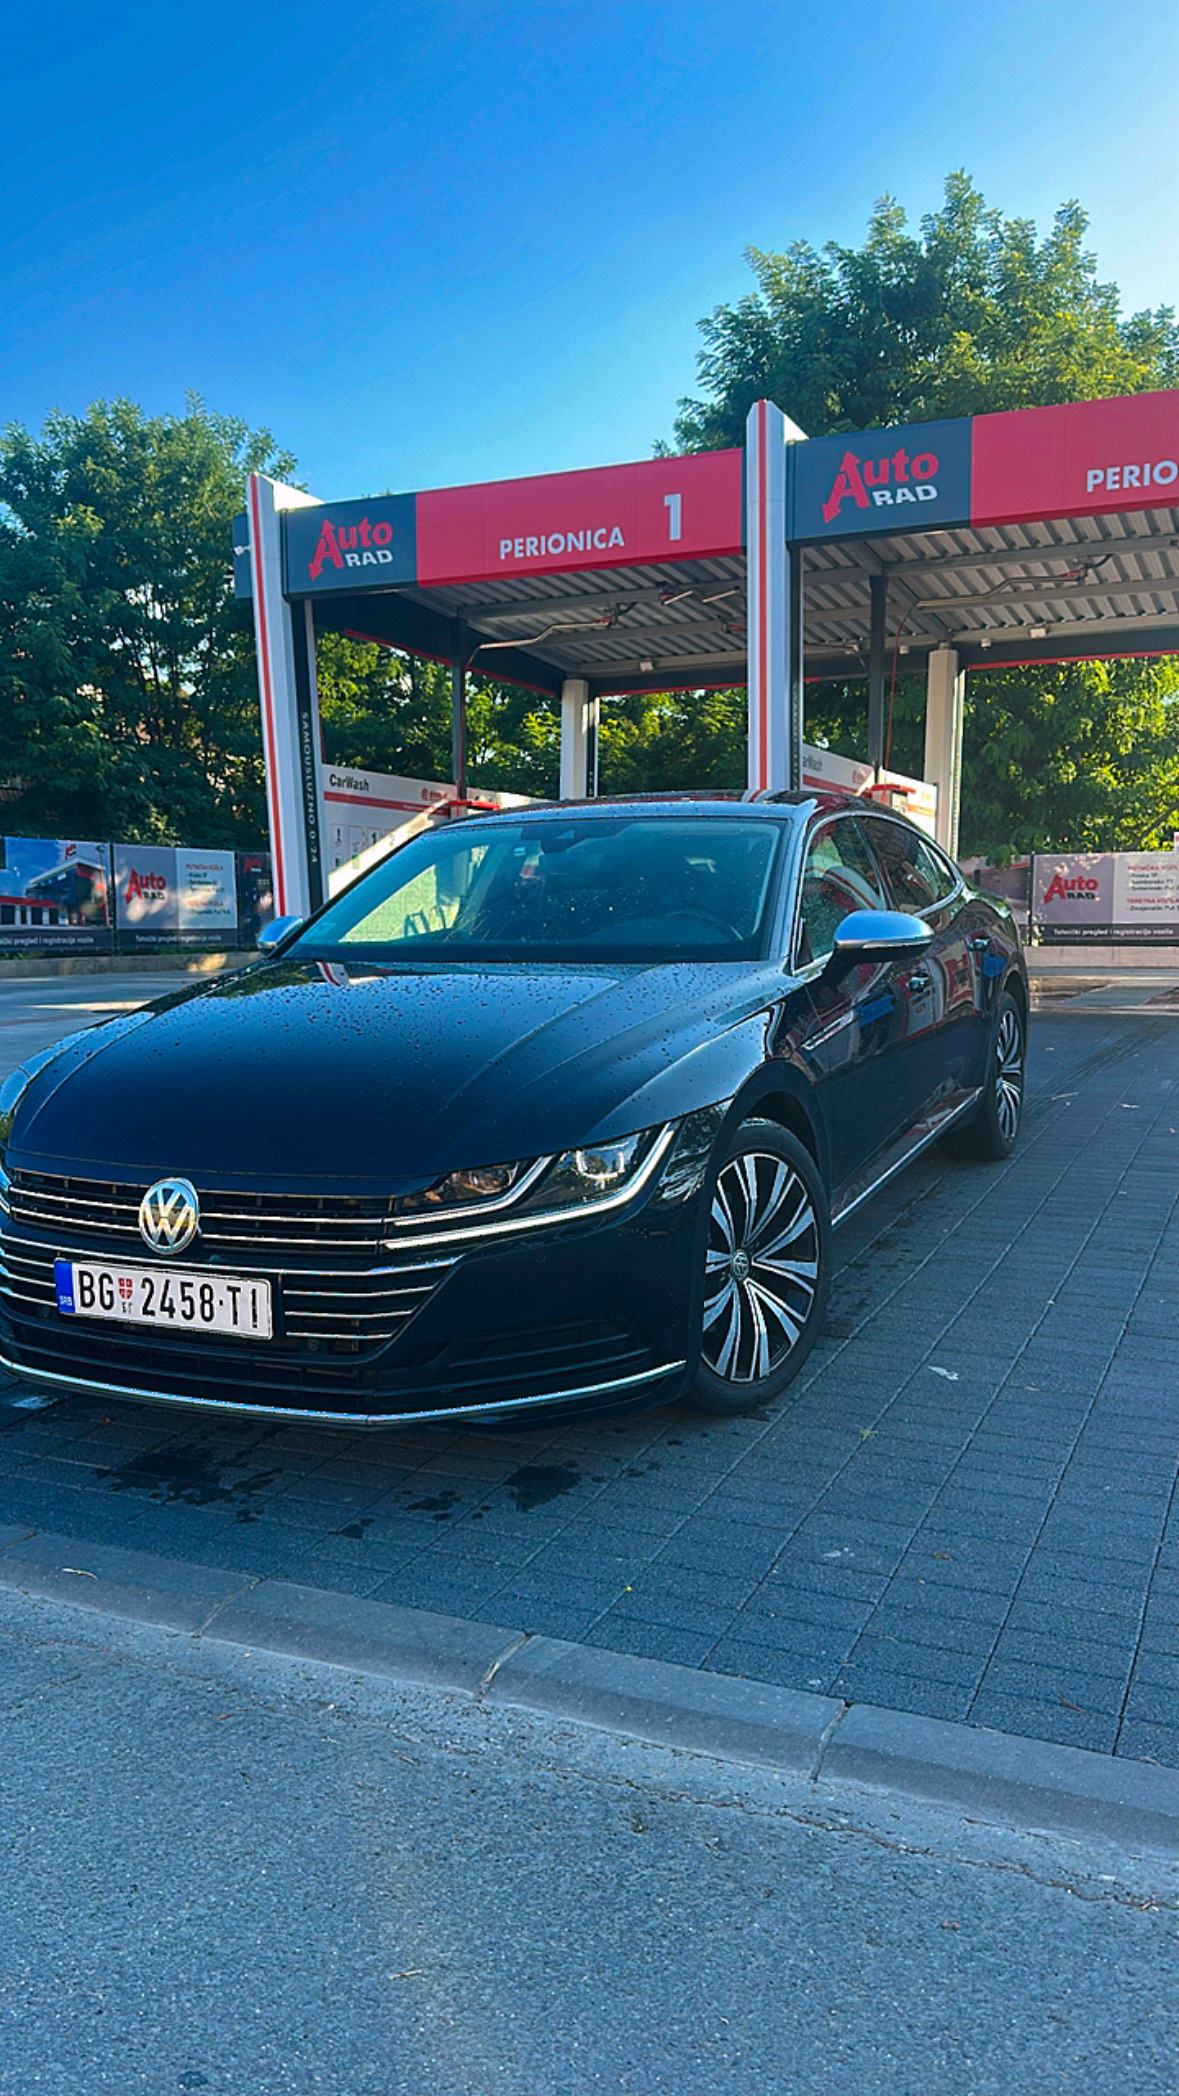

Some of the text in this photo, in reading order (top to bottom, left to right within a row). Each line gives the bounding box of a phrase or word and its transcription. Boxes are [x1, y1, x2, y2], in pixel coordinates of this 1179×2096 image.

[822, 448, 939, 523] Auto
[1087, 460, 1178, 493] PERIO
[872, 484, 938, 507] RAD
[663, 493, 682, 541] 1
[309, 516, 393, 581] Auto
[346, 548, 393, 568] RAD
[500, 526, 625, 560] PERIONICA
[329, 773, 369, 791] CarWash
[125, 868, 166, 904] Auto
[1044, 874, 1098, 904] Auto
[1067, 892, 1096, 900] RAD
[78, 1270, 114, 1310] BG
